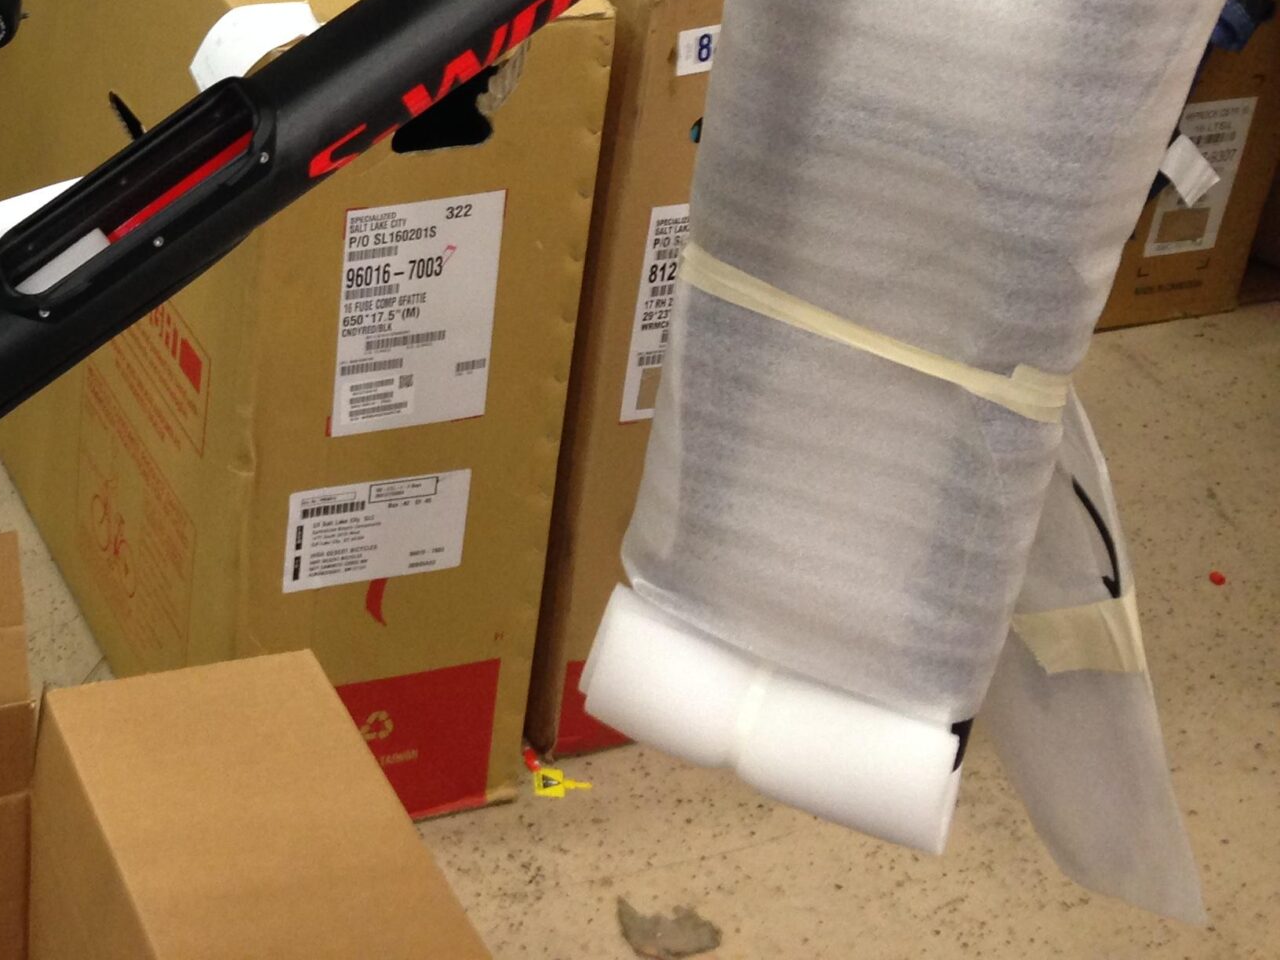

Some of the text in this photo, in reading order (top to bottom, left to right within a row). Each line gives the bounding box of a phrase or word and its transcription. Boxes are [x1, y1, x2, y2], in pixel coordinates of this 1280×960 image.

[350, 204, 473, 225] SPECIALIZED 322
[349, 218, 407, 234] SALT LAKE CITY
[655, 226, 673, 237] SALT
[349, 225, 437, 248] P/O SL160201S
[354, 300, 374, 313] FUSE
[375, 296, 397, 310] COMP
